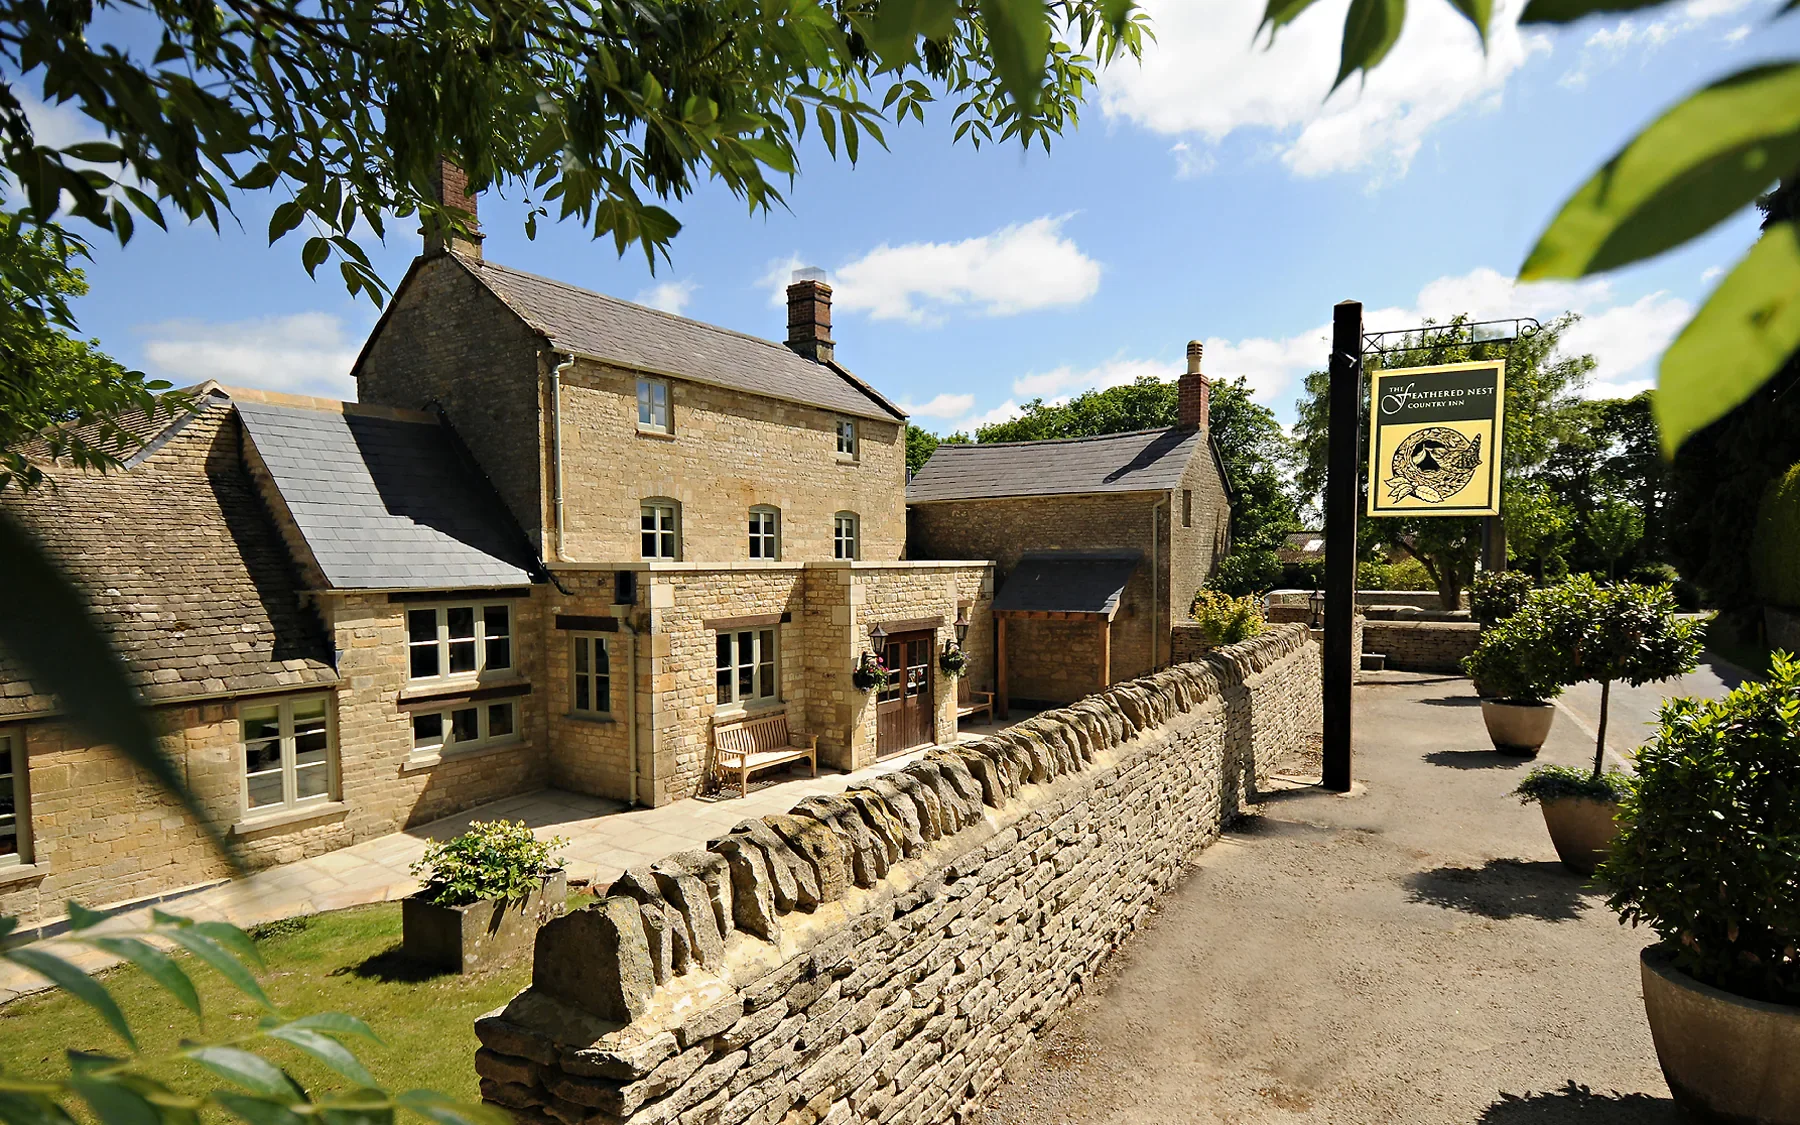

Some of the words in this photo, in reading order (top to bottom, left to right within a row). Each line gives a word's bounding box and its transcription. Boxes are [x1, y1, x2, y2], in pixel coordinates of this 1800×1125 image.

[1381, 382, 1464, 415] FEATHERED
[1467, 387, 1494, 395] NEST
[1407, 401, 1446, 409] COUNTRY
